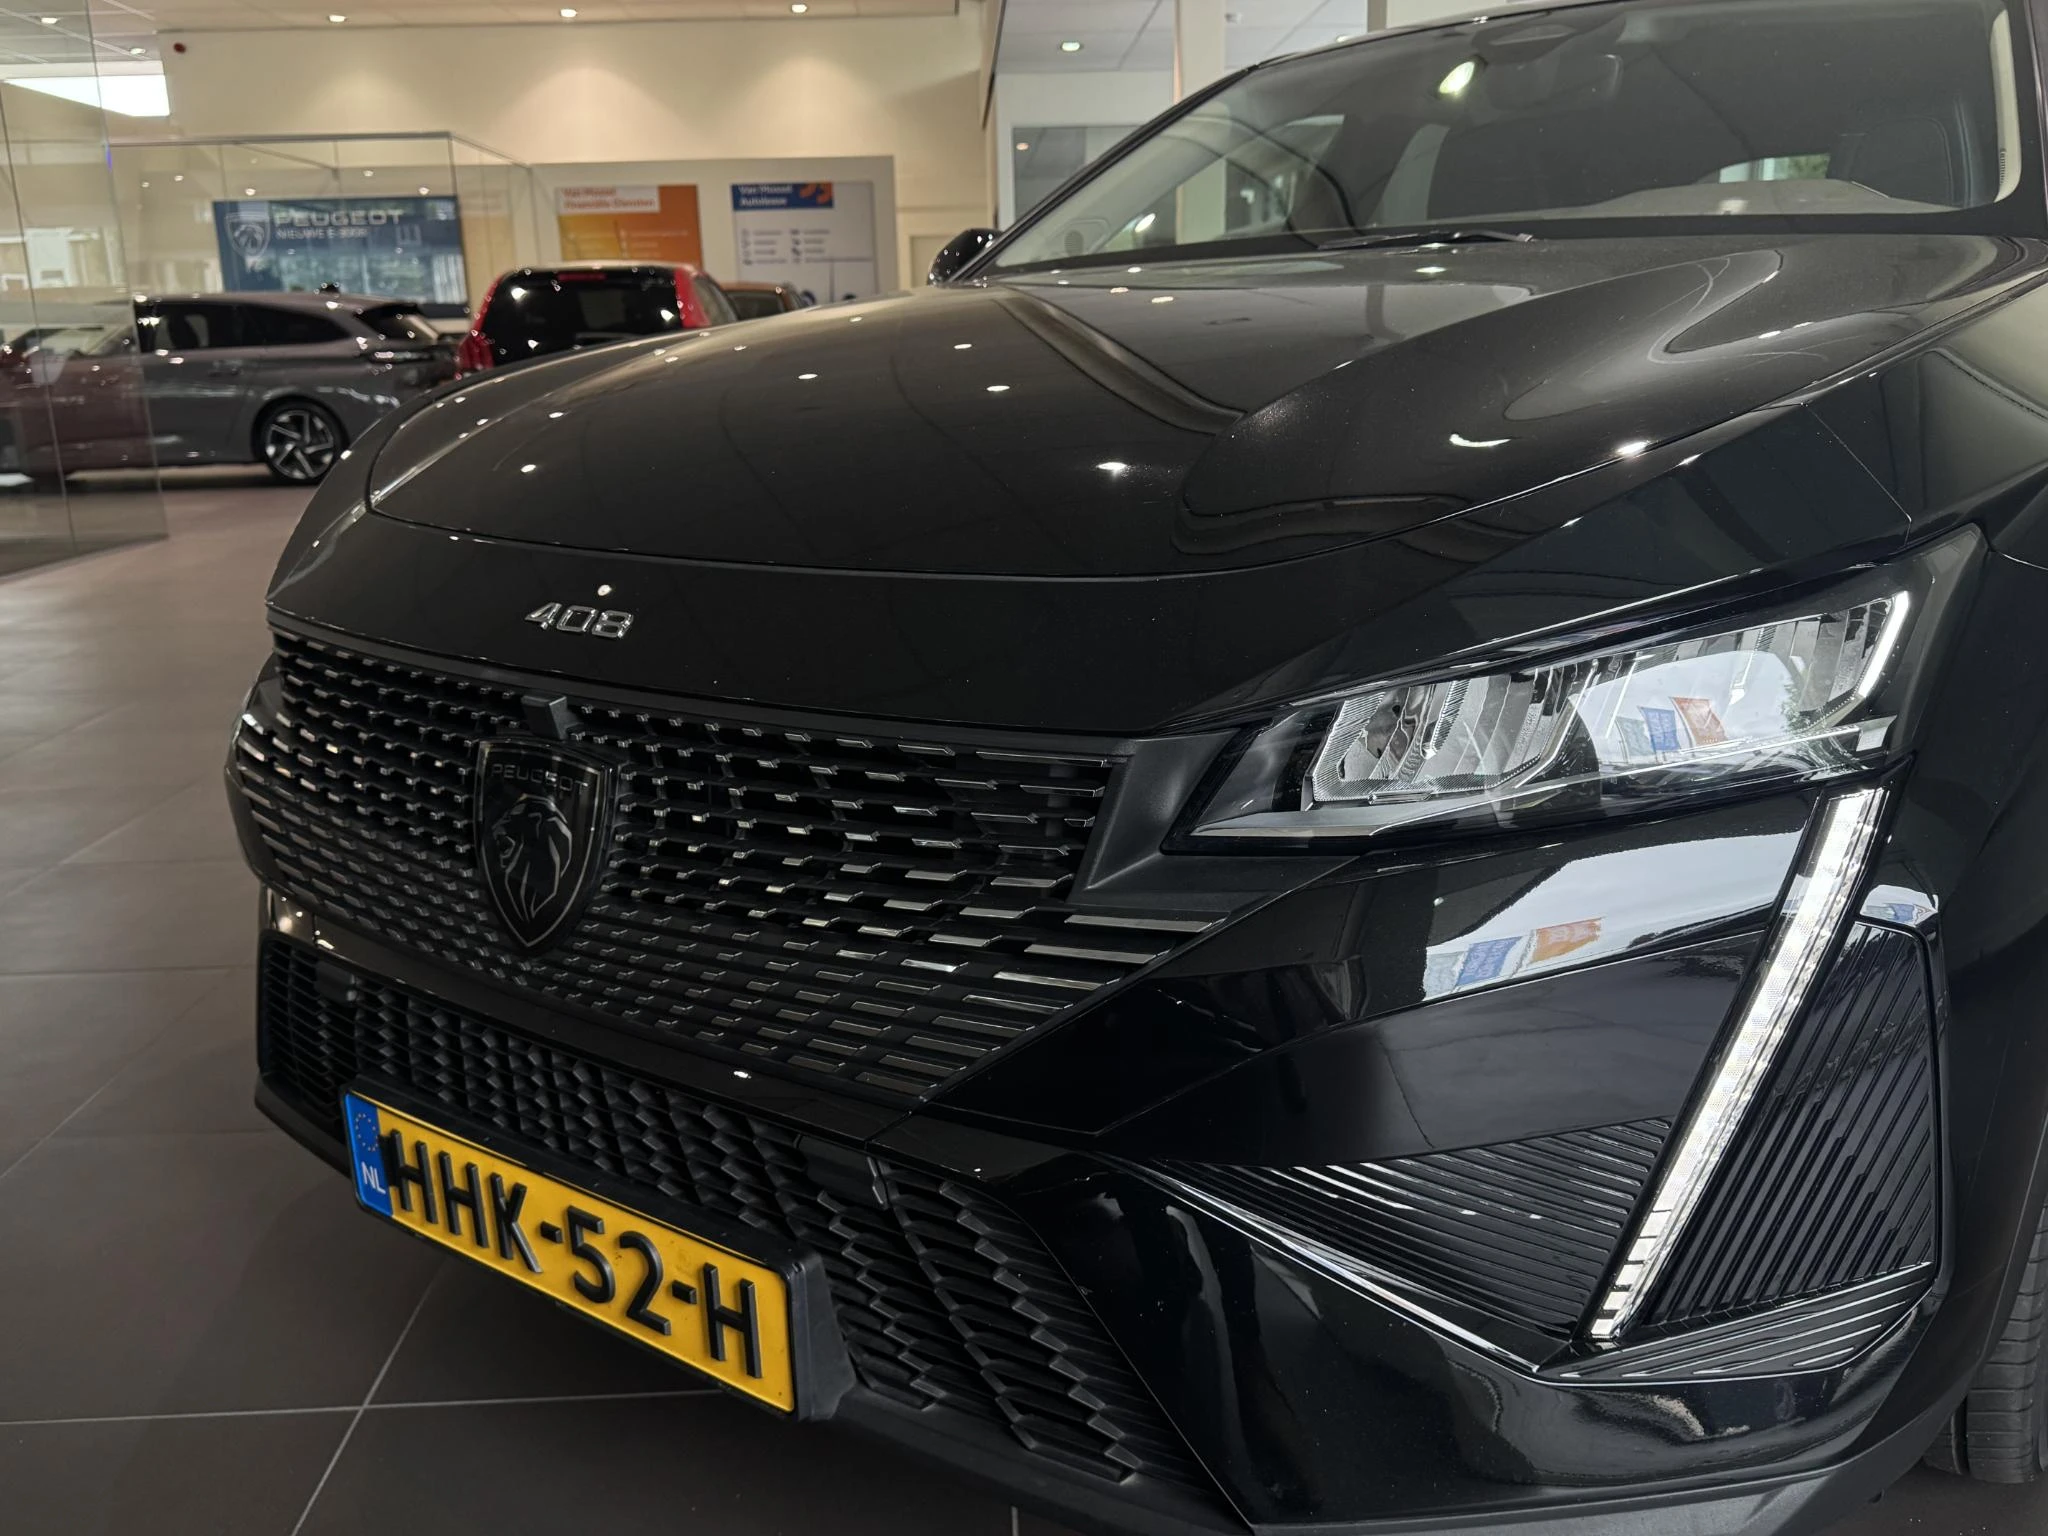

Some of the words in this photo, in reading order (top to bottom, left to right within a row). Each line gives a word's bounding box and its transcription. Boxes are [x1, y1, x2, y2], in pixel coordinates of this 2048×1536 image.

[273, 208, 404, 227] PEUGEOT
[525, 602, 634, 638] 408
[492, 763, 589, 793] PEUGEOT
[361, 1162, 386, 1195] NL
[389, 1128, 763, 1379] HHK-52-H
